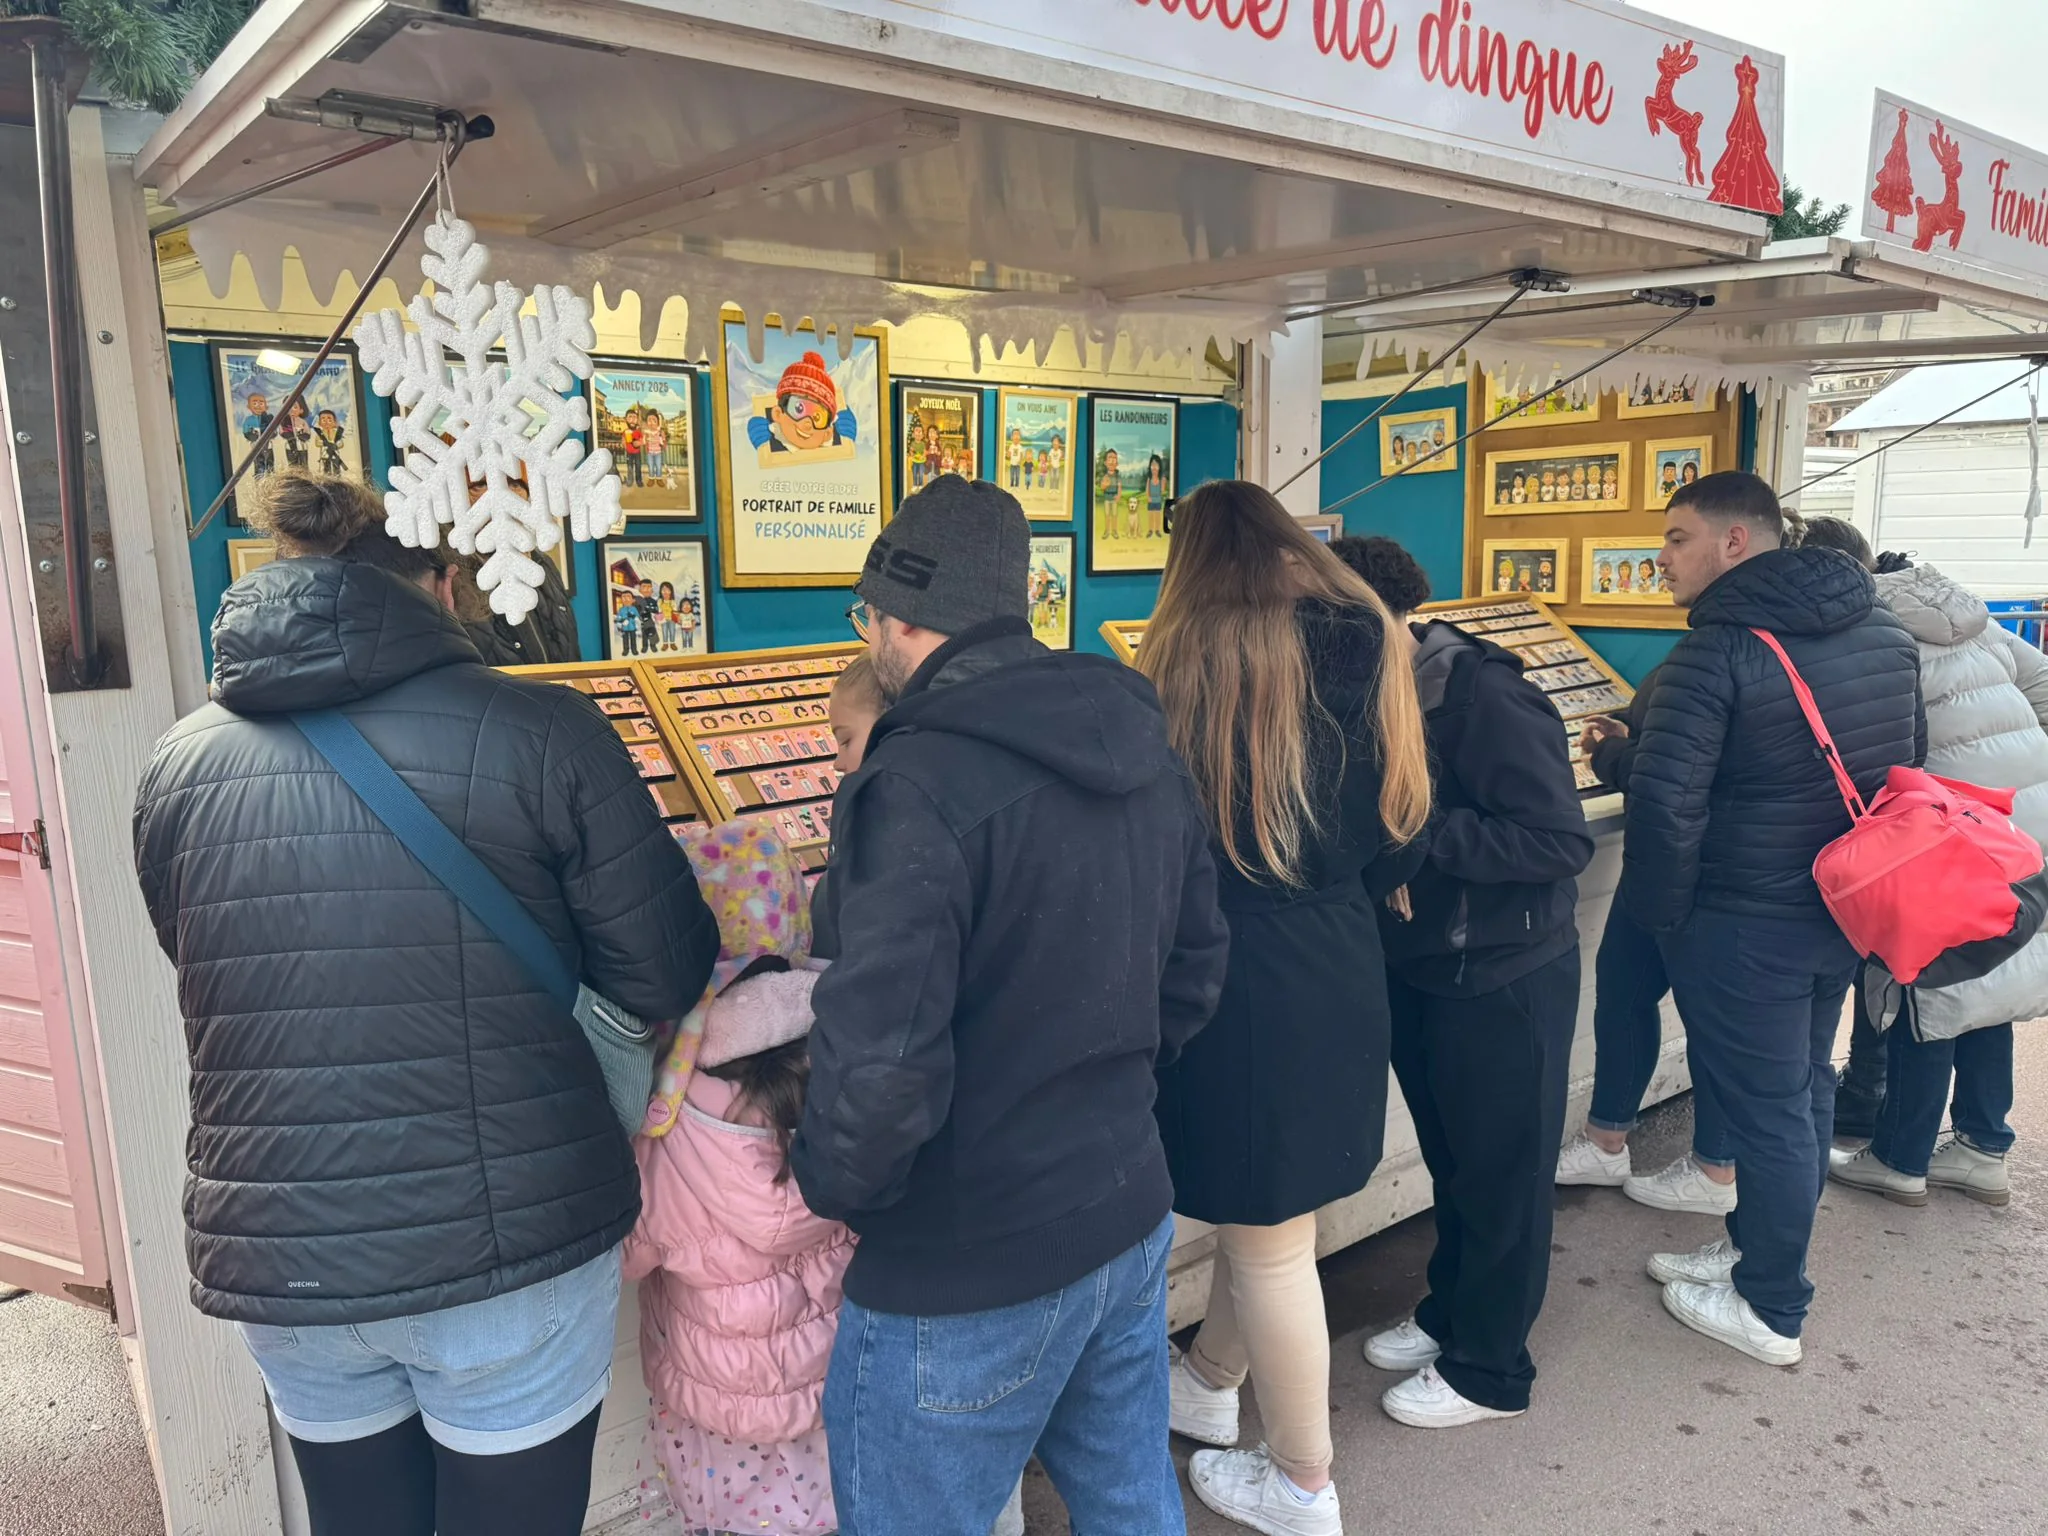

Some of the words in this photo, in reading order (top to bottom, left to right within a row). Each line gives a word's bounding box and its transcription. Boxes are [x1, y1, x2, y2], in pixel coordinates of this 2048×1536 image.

[1418, 0, 1614, 139] dingue
[1988, 158, 2048, 248] Fami
[612, 380, 645, 393] ANNECY
[647, 381, 669, 393] 2025
[919, 397, 944, 410] JOYEUX
[945, 398, 962, 411] NOËL
[1016, 402, 1026, 412] ON
[1027, 403, 1042, 413] VOUS
[1043, 404, 1058, 414] AIME
[1100, 409, 1112, 423] LES
[1115, 410, 1168, 426] RANDONNEURS
[761, 477, 791, 493] CRÉEZ
[792, 481, 825, 495] VOTRE
[827, 483, 859, 496] CADRE
[742, 499, 803, 513] PORTRAIT
[807, 501, 825, 513] DE
[828, 501, 876, 515] FAMILLE
[755, 519, 866, 540] PERSONNALISÉ
[637, 551, 672, 562] AVORIAZ
[287, 1281, 321, 1289] QUECHUA
